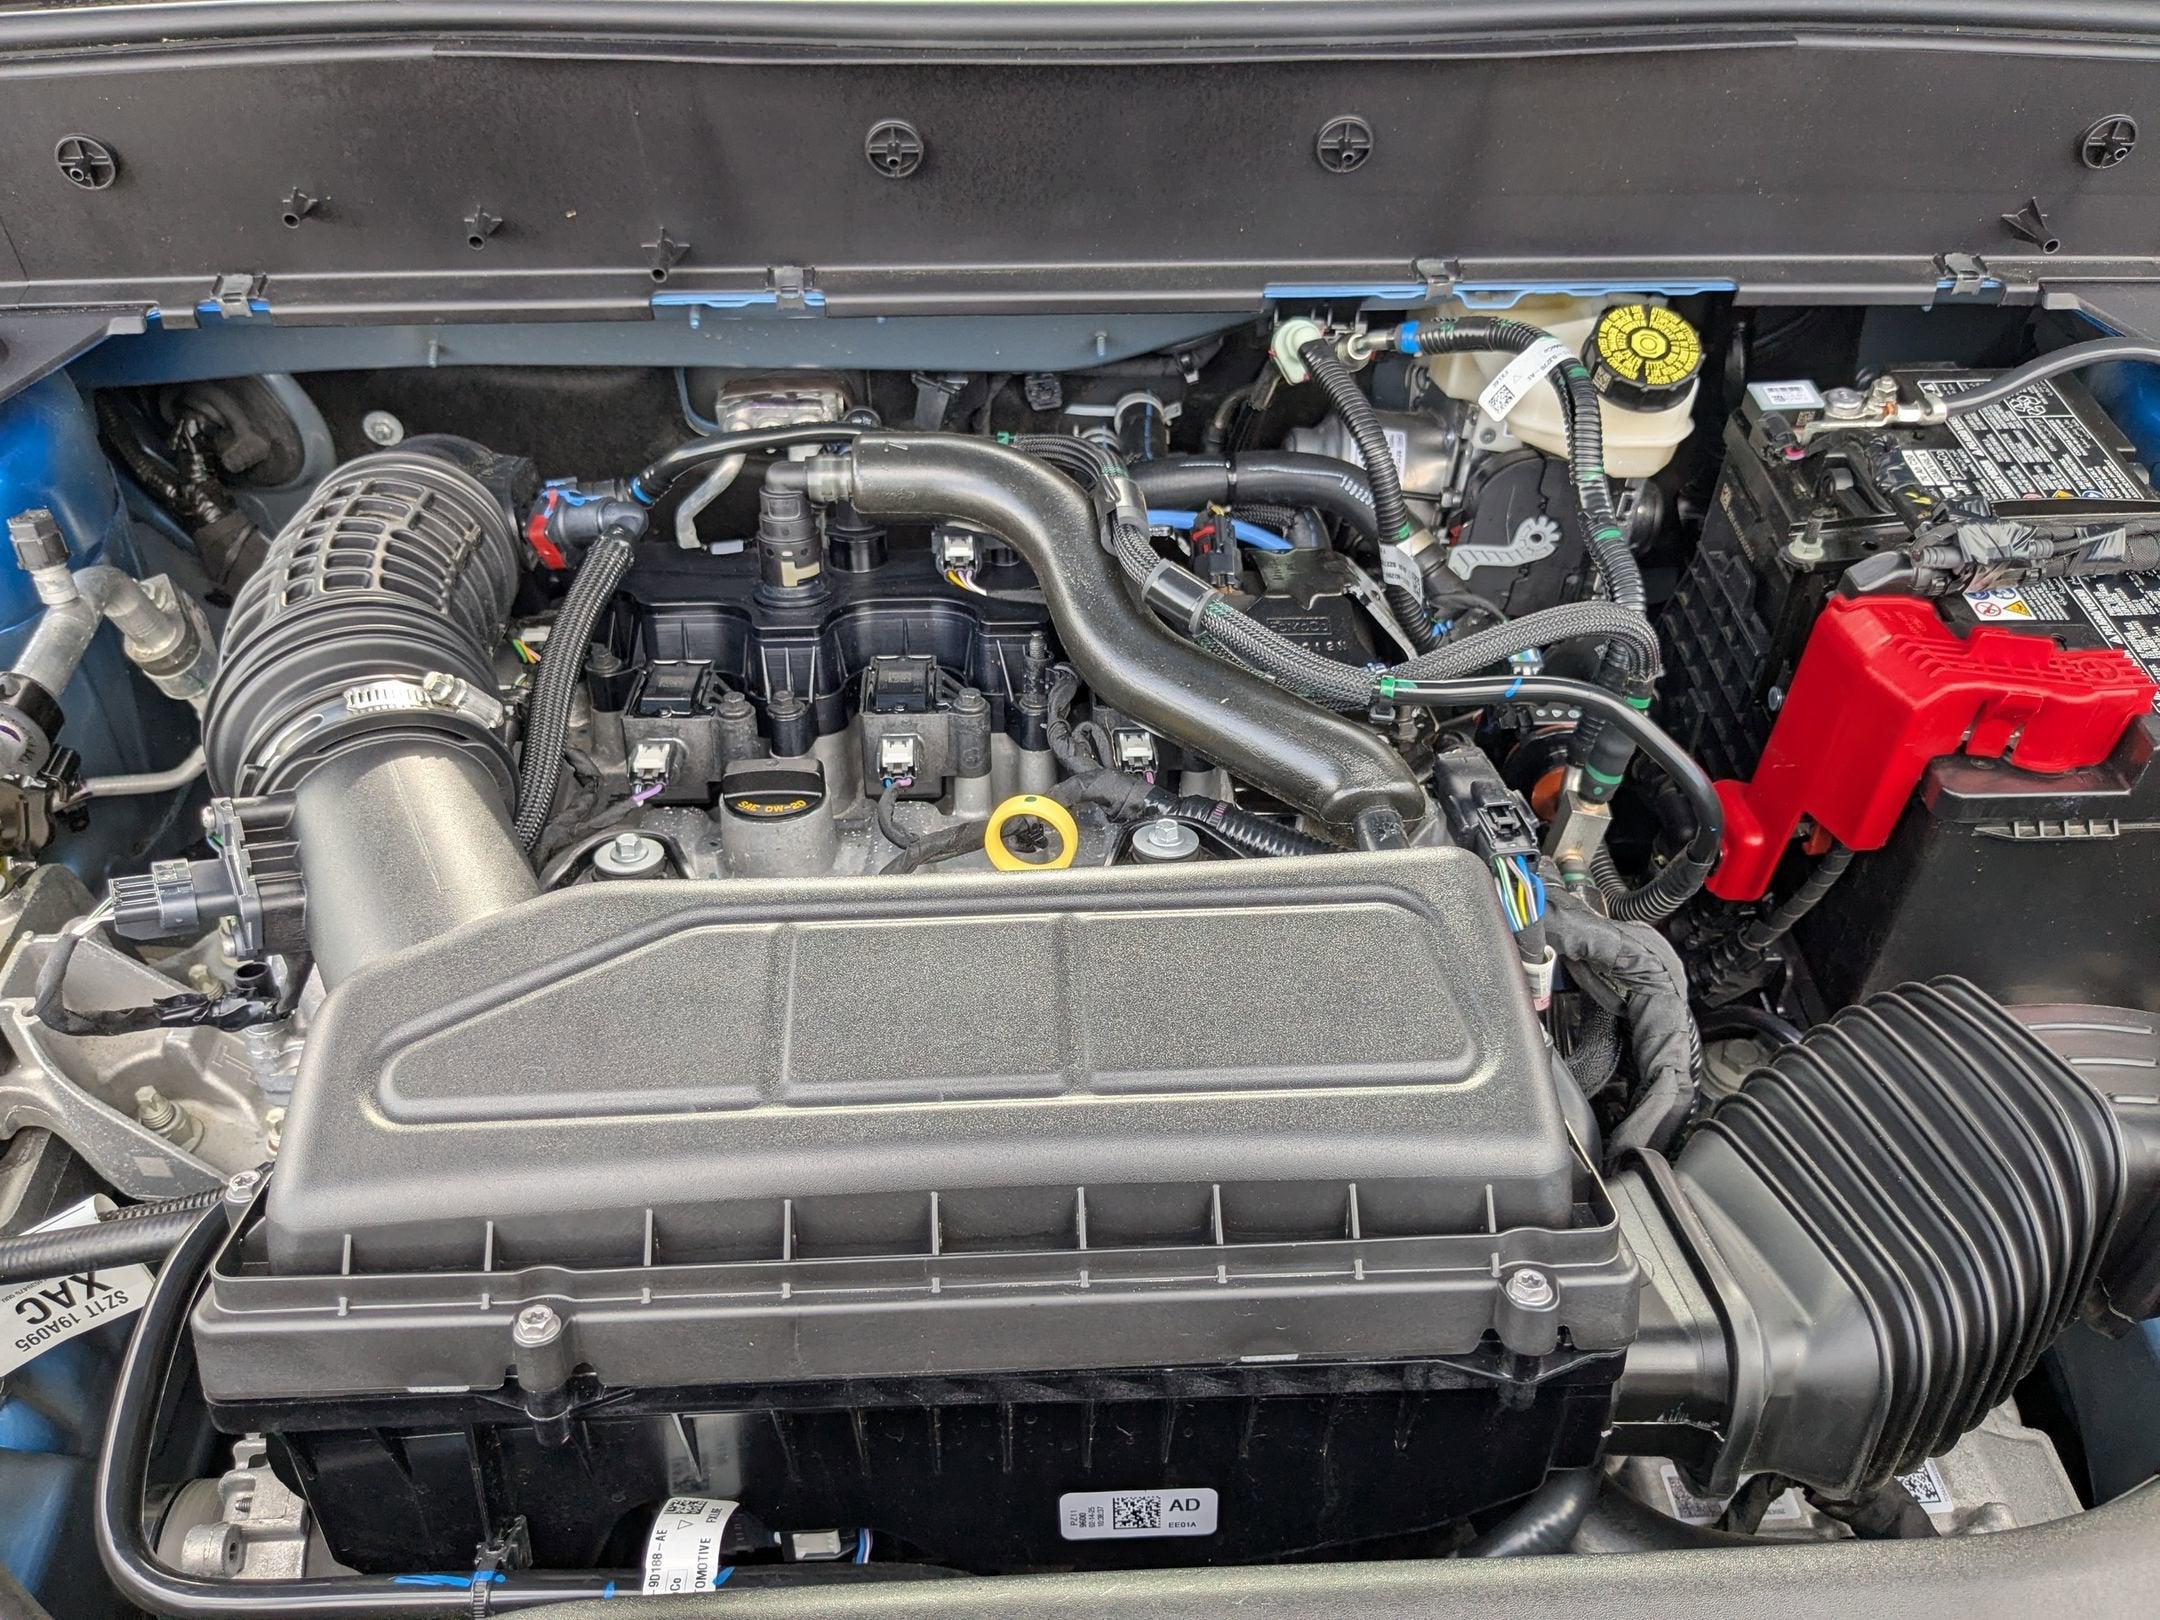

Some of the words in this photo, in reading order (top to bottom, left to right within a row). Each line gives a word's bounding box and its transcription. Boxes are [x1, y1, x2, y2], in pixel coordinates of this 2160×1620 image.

[737, 800, 761, 812] SAE
[764, 799, 807, 813] 0W-20
[15, 1272, 114, 1325] XAC
[84, 1290, 129, 1319] SZ1T
[15, 1312, 81, 1352] 19A095
[1169, 1498, 1201, 1512] AD
[1079, 1512, 1087, 1528] 9600
[1168, 1521, 1197, 1529] EE01A
[670, 1577, 682, 1594] Co
